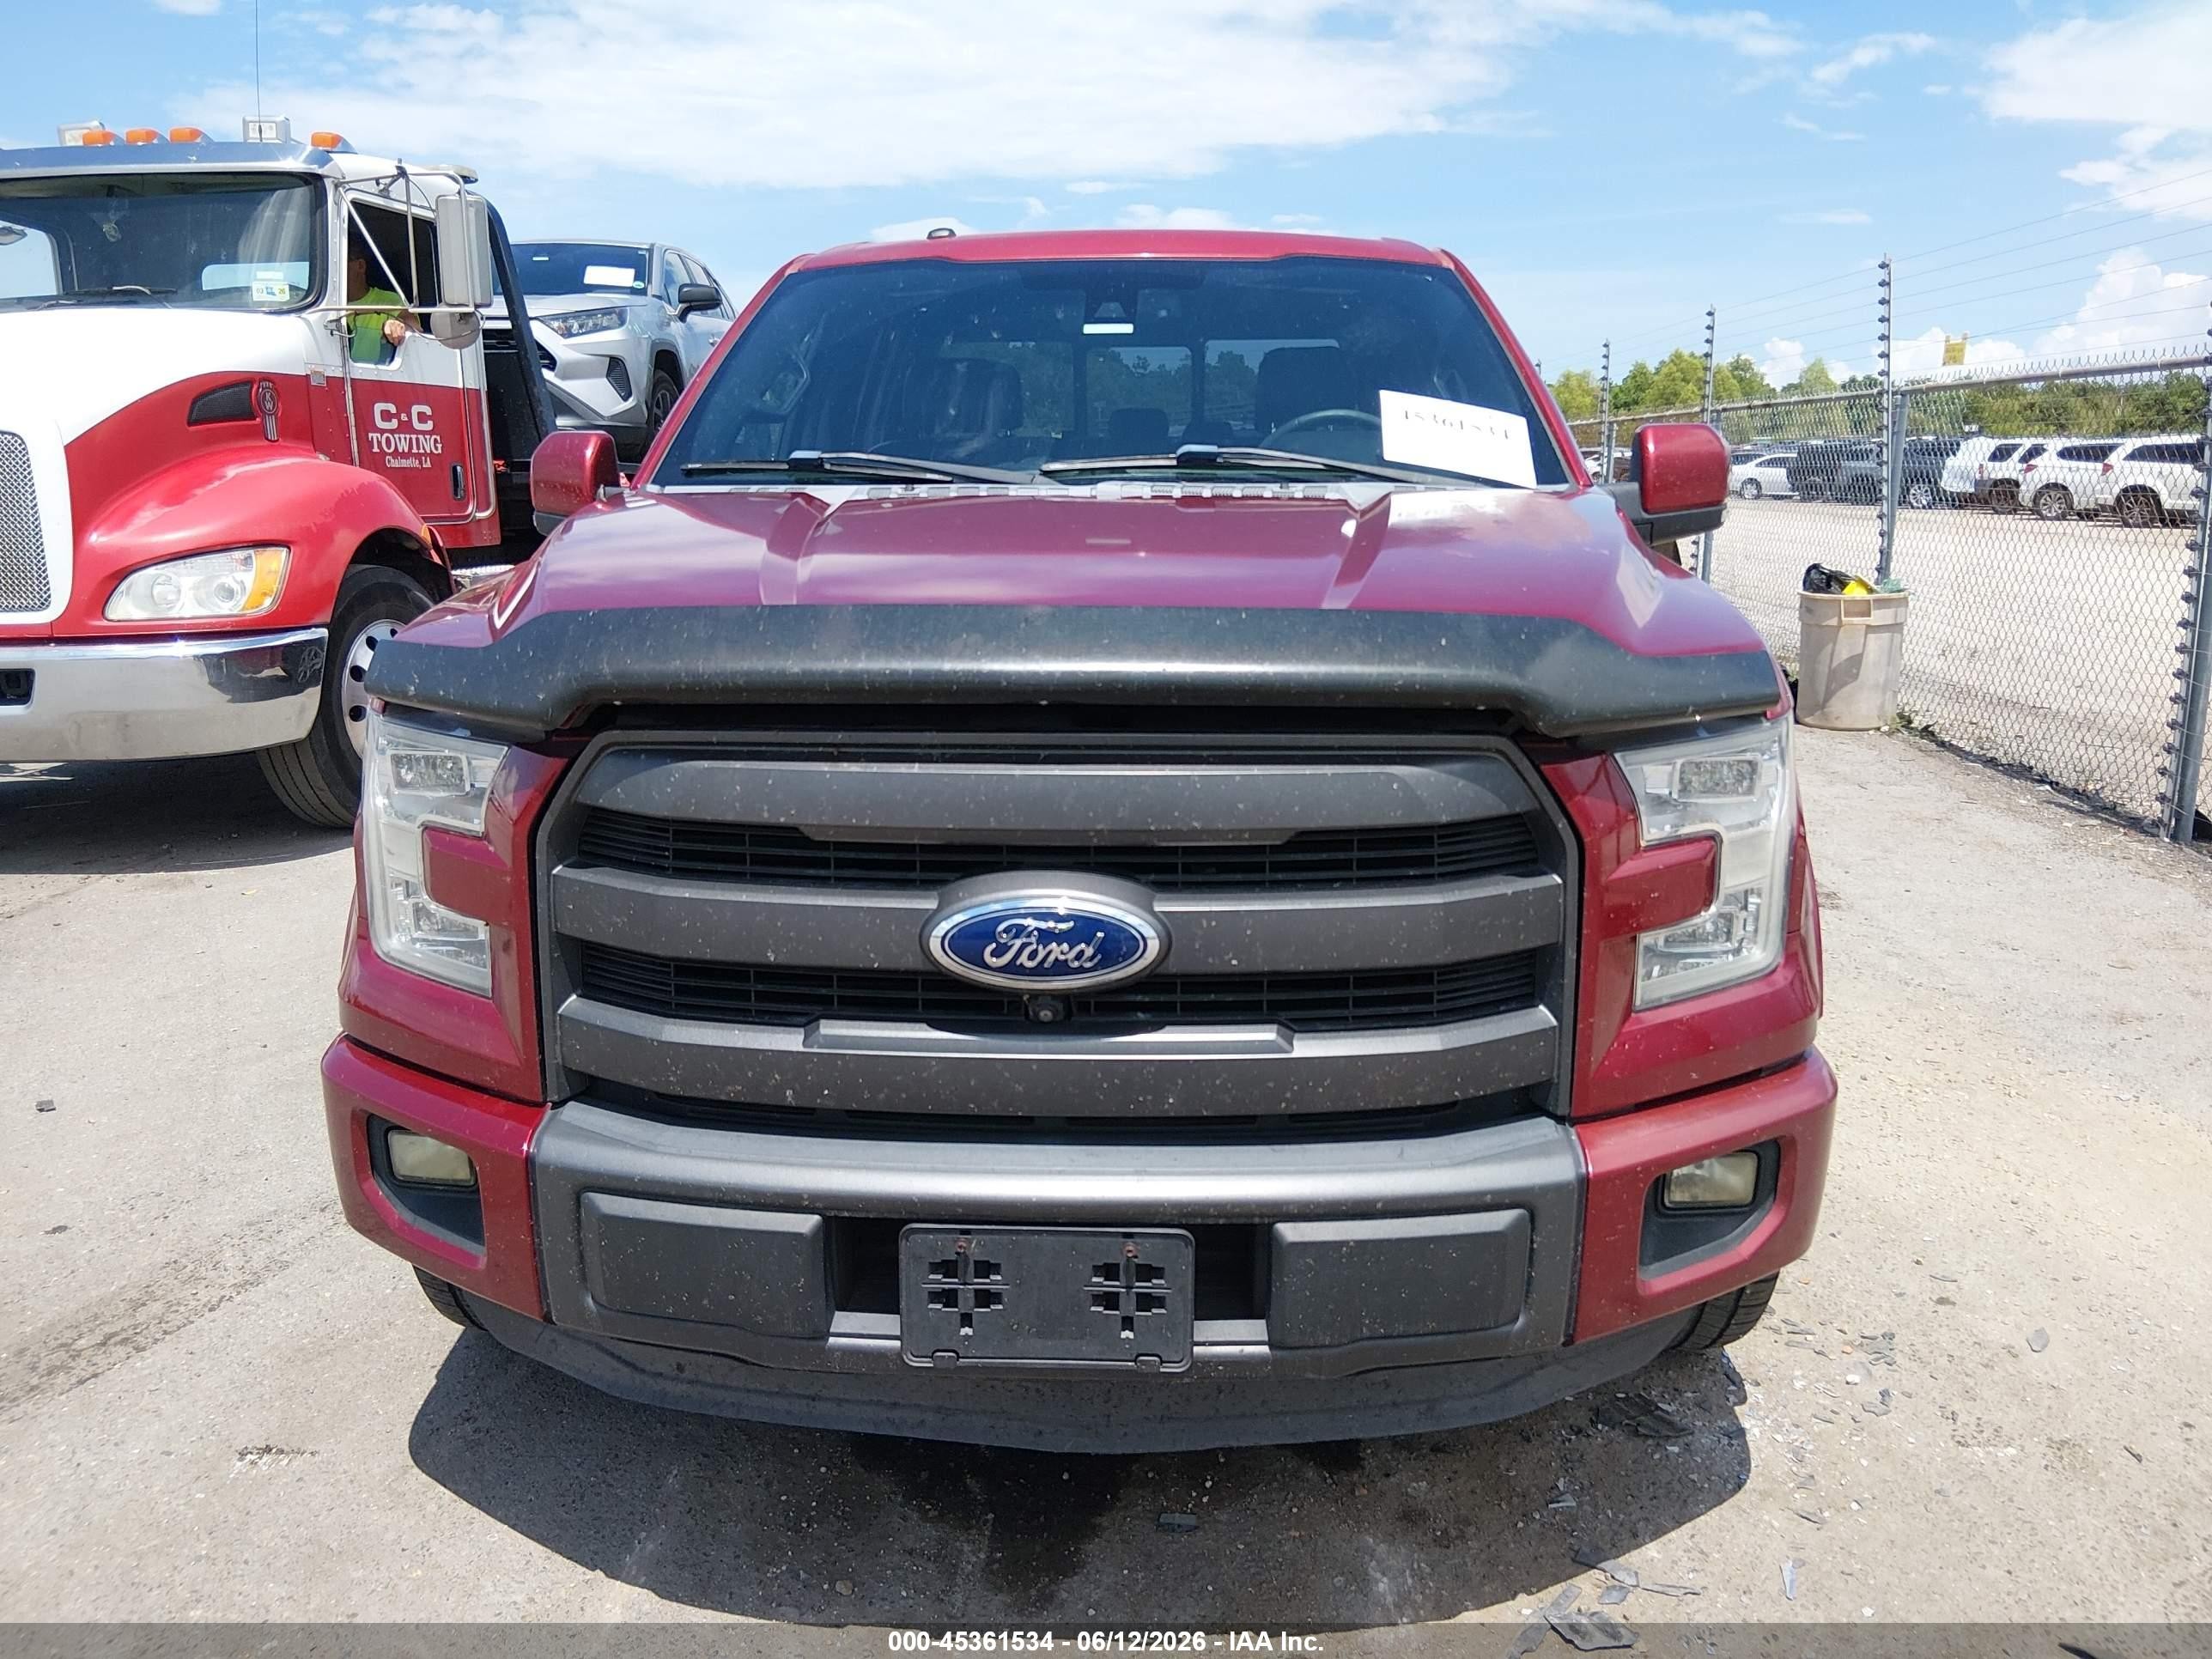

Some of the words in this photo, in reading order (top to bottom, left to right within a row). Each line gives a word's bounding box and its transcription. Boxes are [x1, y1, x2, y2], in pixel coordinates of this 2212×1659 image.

[368, 433, 443, 454] TOWING
[422, 457, 432, 468] LA
[983, 917, 1105, 969] Ford
